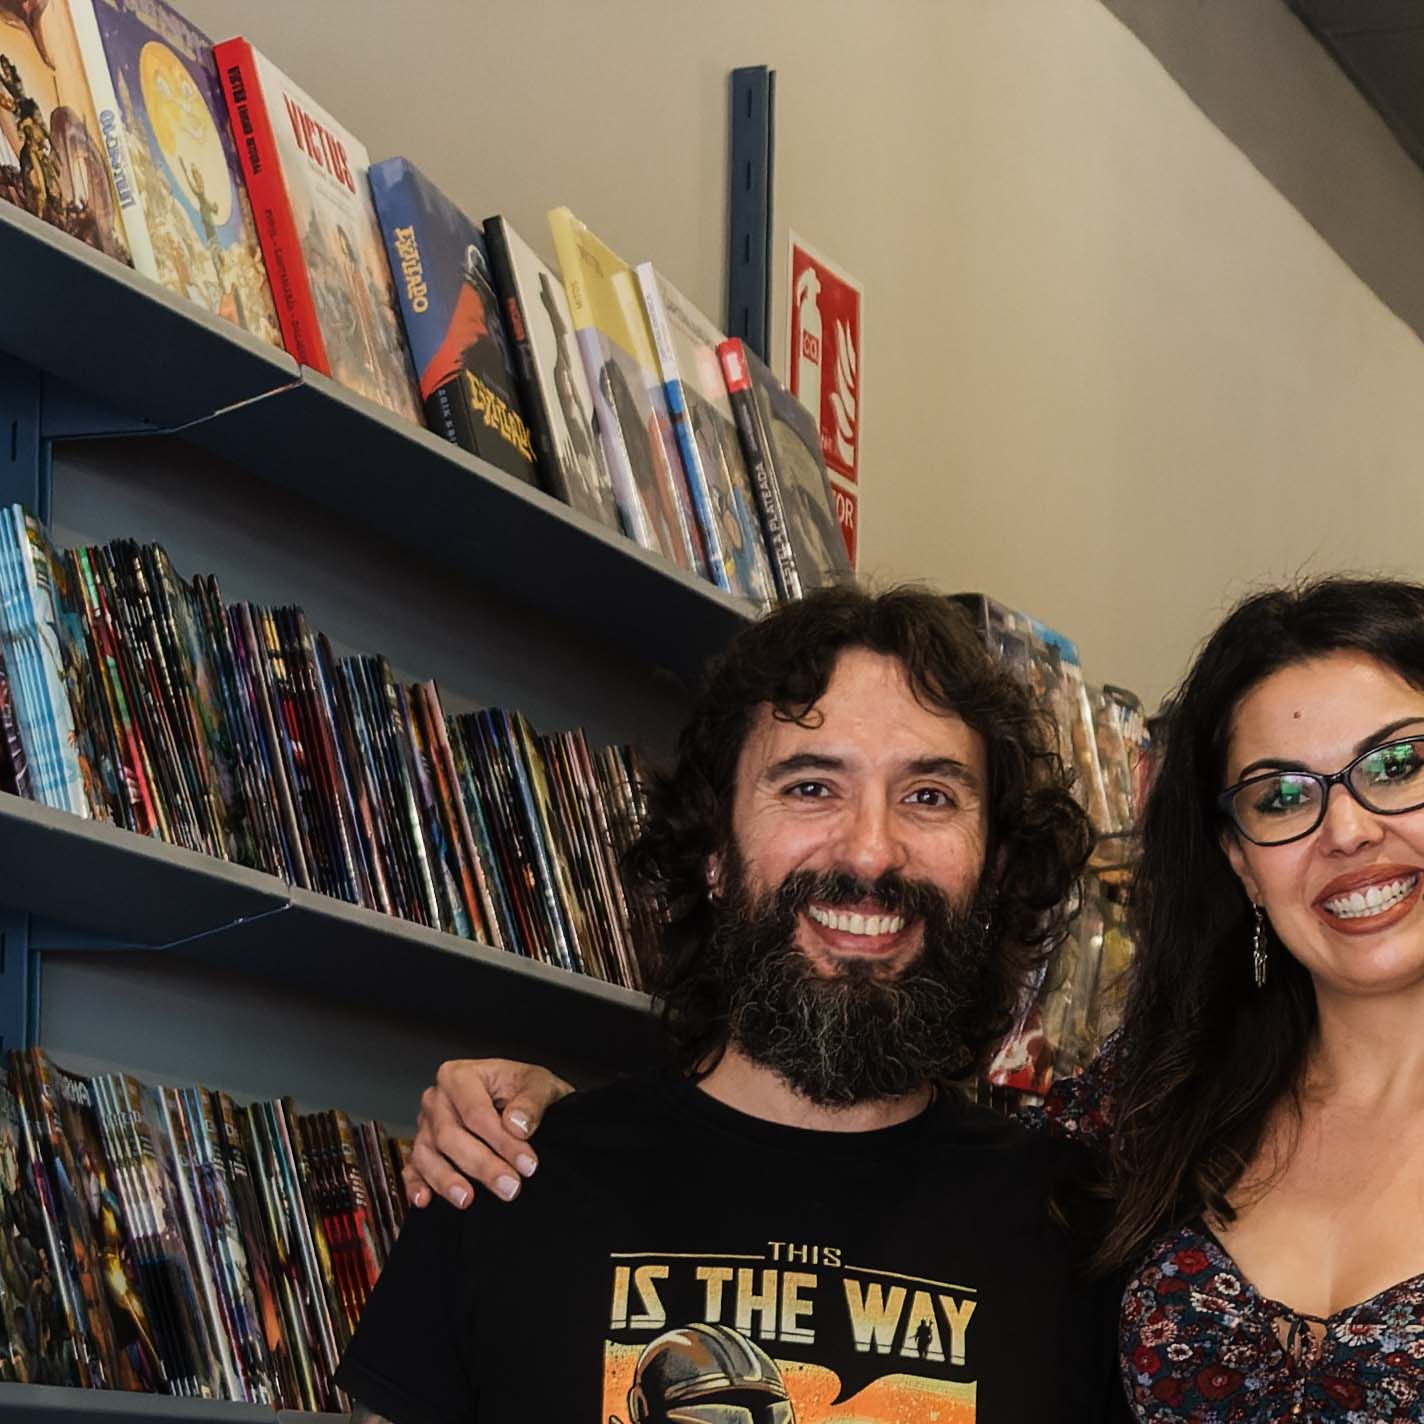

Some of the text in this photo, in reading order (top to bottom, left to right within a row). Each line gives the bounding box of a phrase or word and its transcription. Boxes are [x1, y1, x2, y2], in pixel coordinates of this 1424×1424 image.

[282, 91, 356, 194] VICTUS
[753, 461, 781, 532] PLATEADA
[767, 1241, 843, 1268] THIS
[609, 1265, 979, 1367] IS THE WAY
